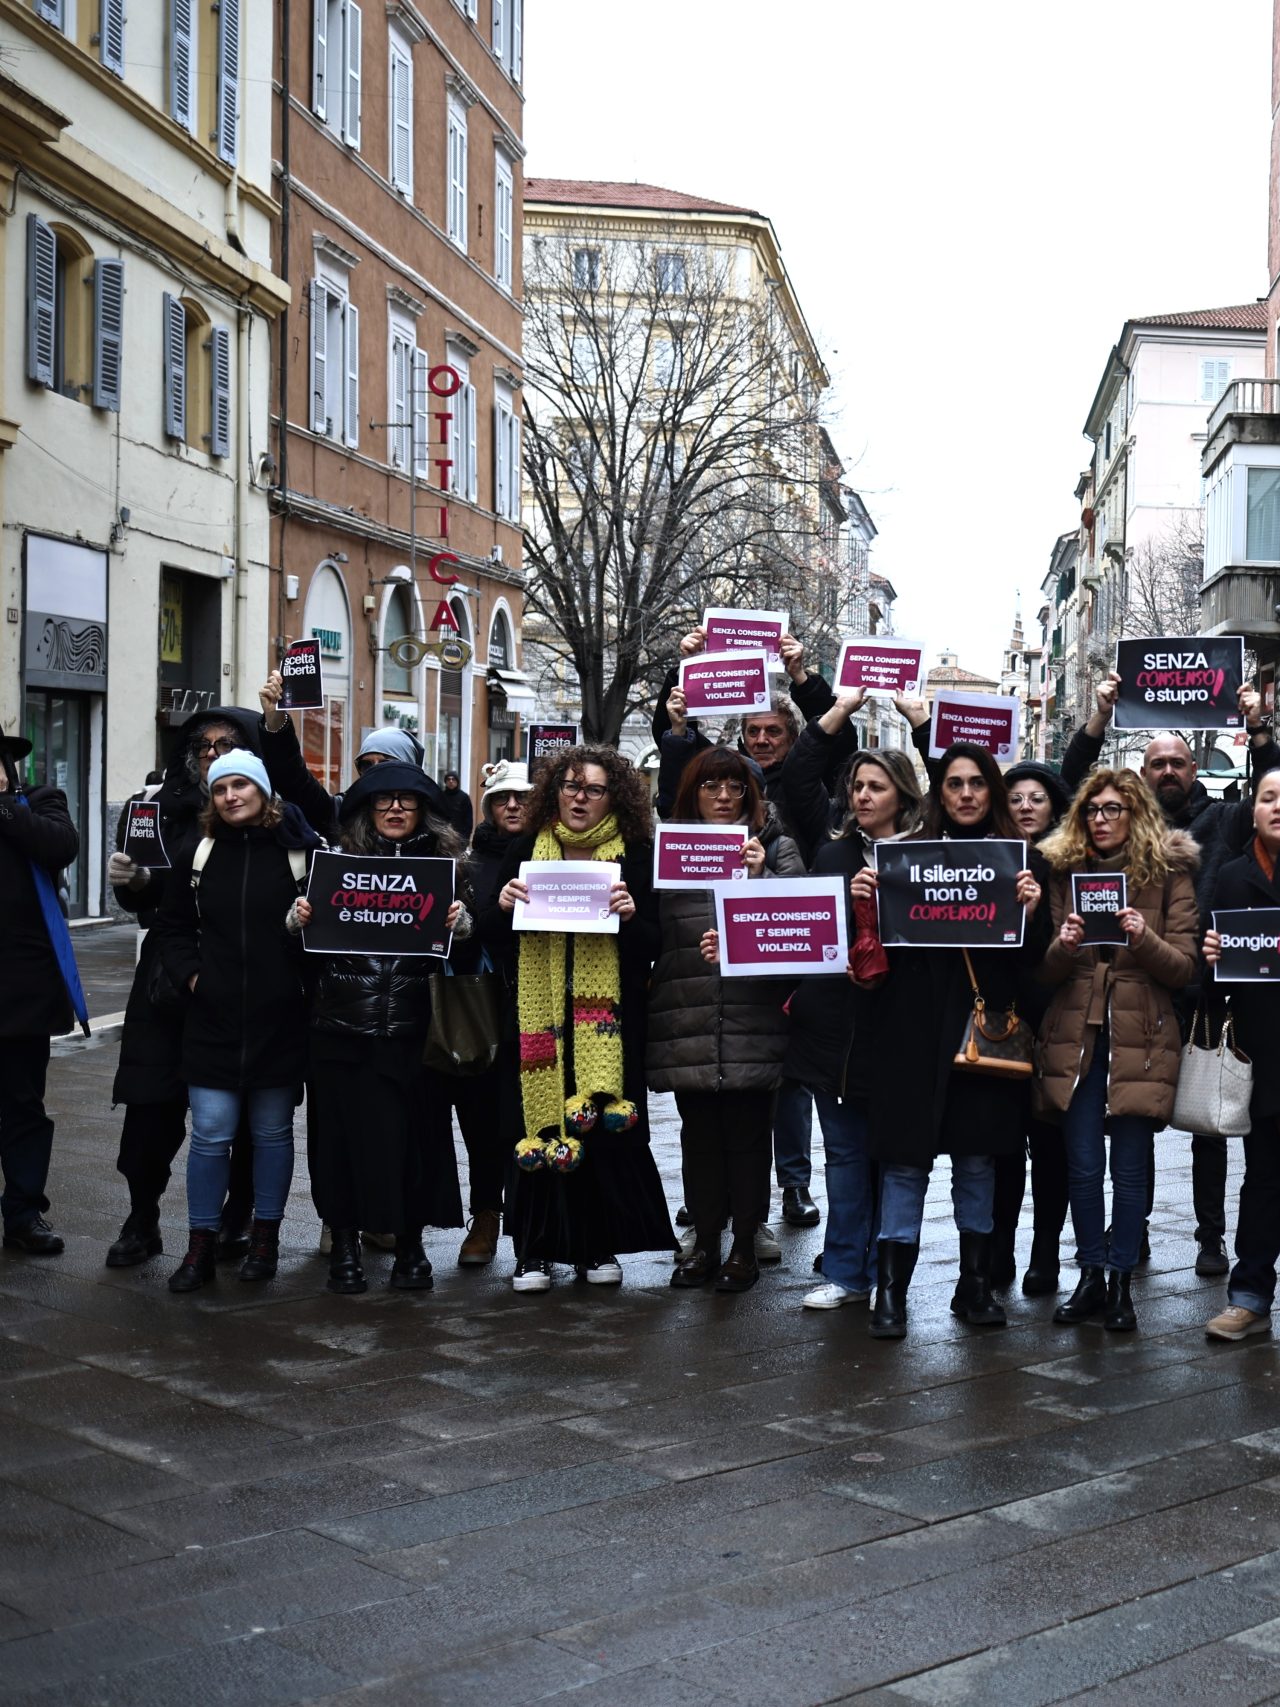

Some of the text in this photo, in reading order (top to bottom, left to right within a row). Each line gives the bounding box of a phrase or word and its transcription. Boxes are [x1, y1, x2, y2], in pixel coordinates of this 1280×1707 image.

[428, 365, 461, 631] OTTICA
[712, 627, 777, 638] SENZA CONSENSO
[733, 639, 763, 647] SEMPRE
[284, 653, 315, 666] scelta
[849, 654, 916, 665] SENZA CONSENSO
[1144, 652, 1208, 670] SENZA
[283, 664, 316, 676] libertà
[688, 669, 760, 680] SENZA CONSENSO
[870, 665, 900, 674] SEMPRE
[712, 681, 745, 689] SEMPRE
[861, 675, 898, 684] VIOLENZA
[705, 691, 746, 700] VIOLENZA
[1144, 687, 1208, 705] è stupro
[941, 712, 1007, 727] SENZA CONSENSO
[960, 726, 991, 736] SEMPRE
[535, 737, 570, 748] scelta
[131, 816, 154, 827] scelta
[129, 827, 155, 838] libertà
[694, 843, 741, 851] CONSENSO
[690, 855, 724, 863] SEMPRE
[910, 864, 996, 883] Il silenzio
[341, 872, 417, 893] SENZA
[531, 883, 608, 891] SENZA CONSENSO
[925, 884, 978, 901] non è
[1080, 889, 1119, 901] scelta
[557, 895, 591, 903] SEMPRE
[1081, 900, 1119, 913] libertà
[339, 907, 414, 927] è stupro
[732, 911, 831, 922] SENZA CONSENSO
[756, 927, 811, 937] E' SEMPRE
[757, 943, 812, 952] VIOLENZA
